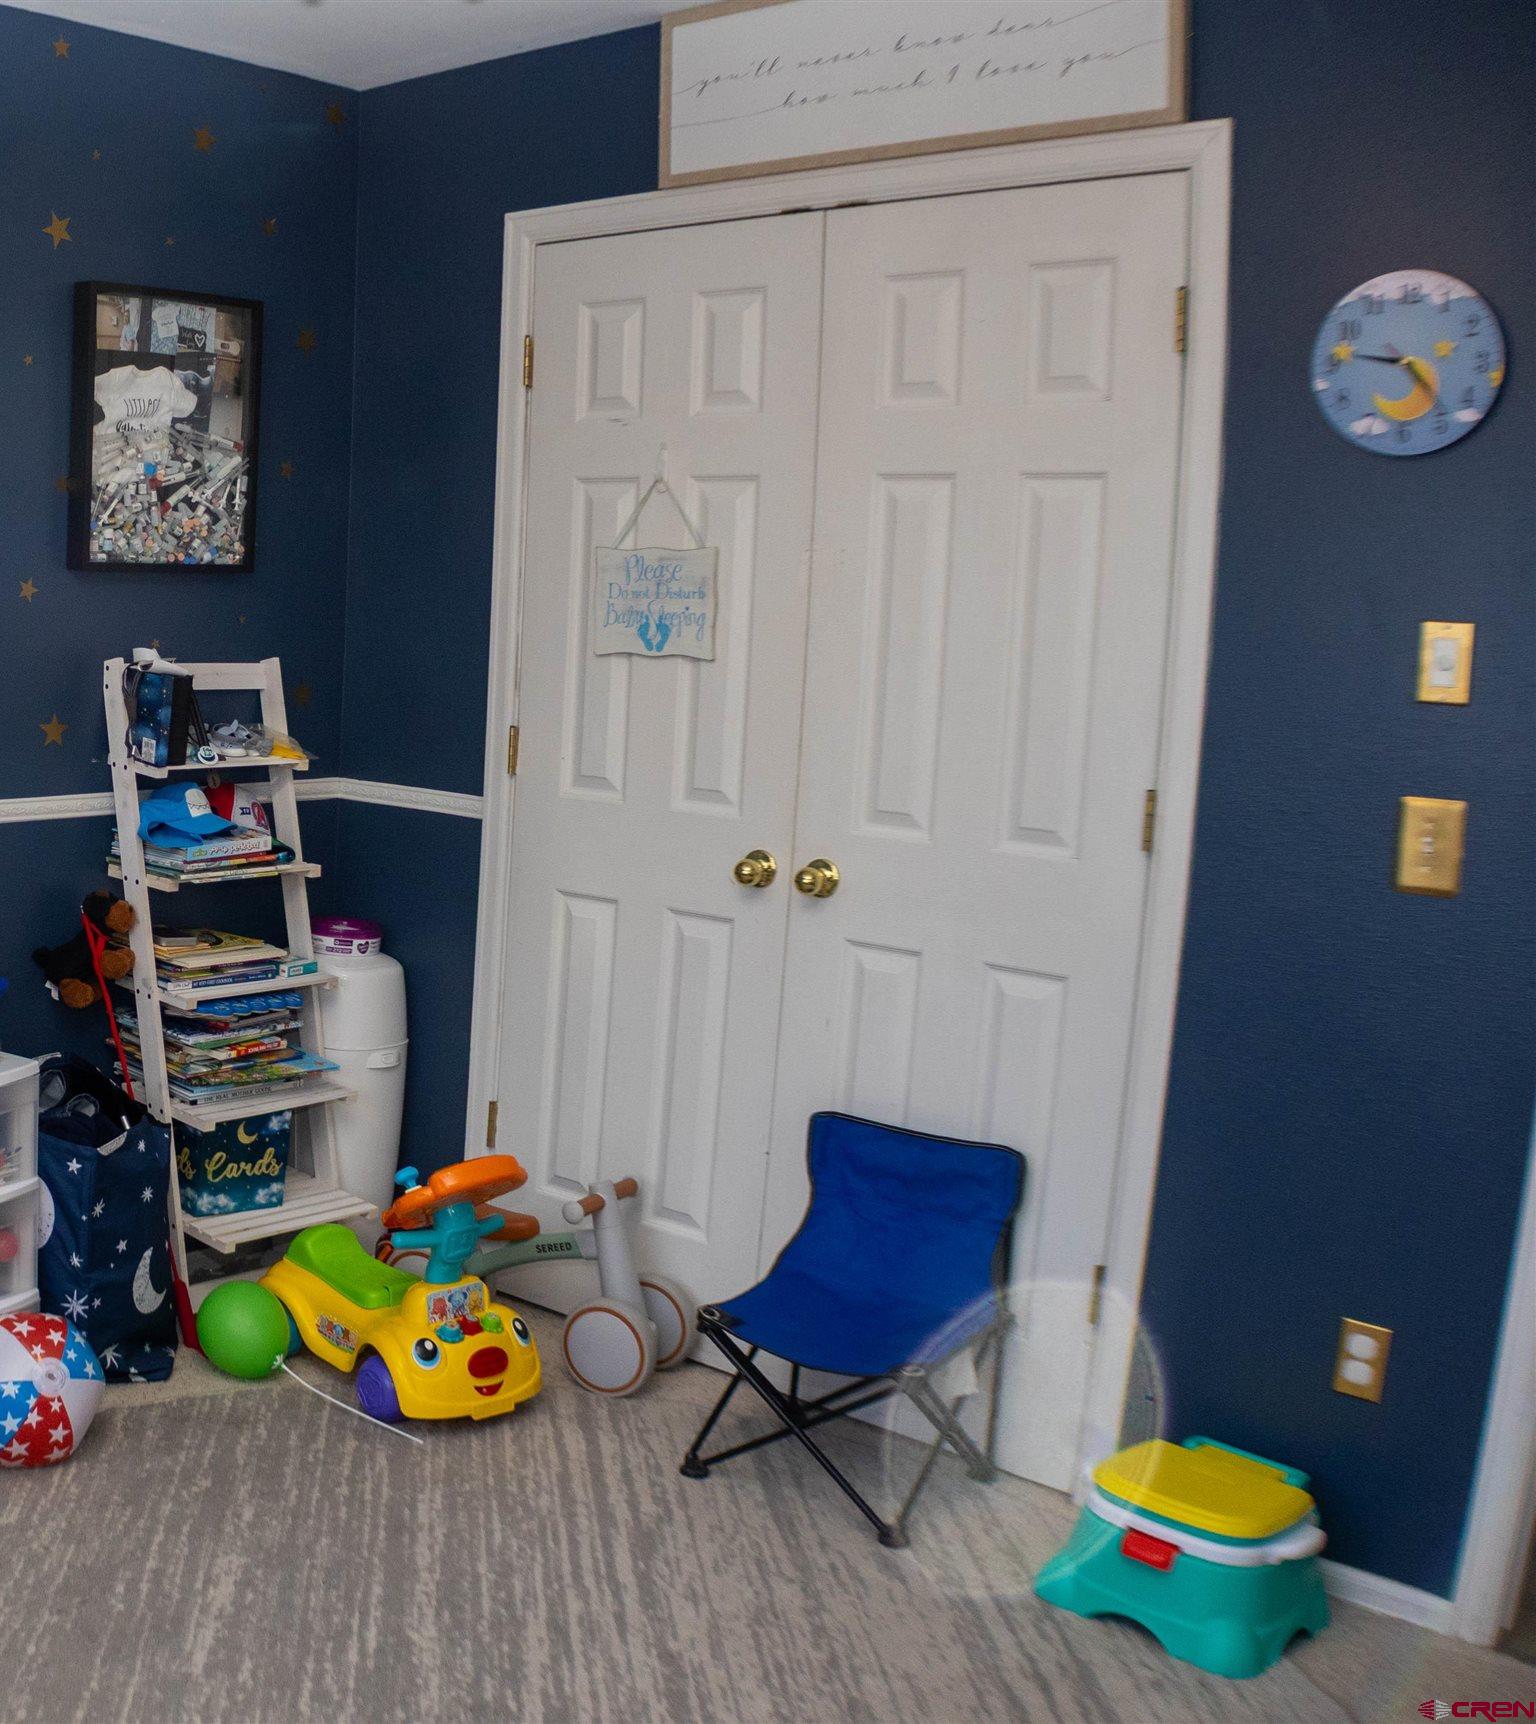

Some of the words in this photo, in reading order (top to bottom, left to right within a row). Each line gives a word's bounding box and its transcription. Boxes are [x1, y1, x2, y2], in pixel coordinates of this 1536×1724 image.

[689, 56, 781, 97] you'll
[797, 46, 880, 69] never
[894, 32, 976, 54] know
[778, 90, 837, 110] how
[852, 70, 934, 96] much
[975, 58, 1048, 81] love
[1061, 46, 1132, 78] you
[625, 554, 682, 586] Please
[608, 582, 628, 600] Do
[631, 587, 650, 600] not
[655, 581, 706, 600] Disturb
[603, 600, 645, 628] Baby
[647, 600, 706, 641] Sleeping
[205, 1147, 283, 1182] Cards
[535, 1241, 573, 1254] SEREED
